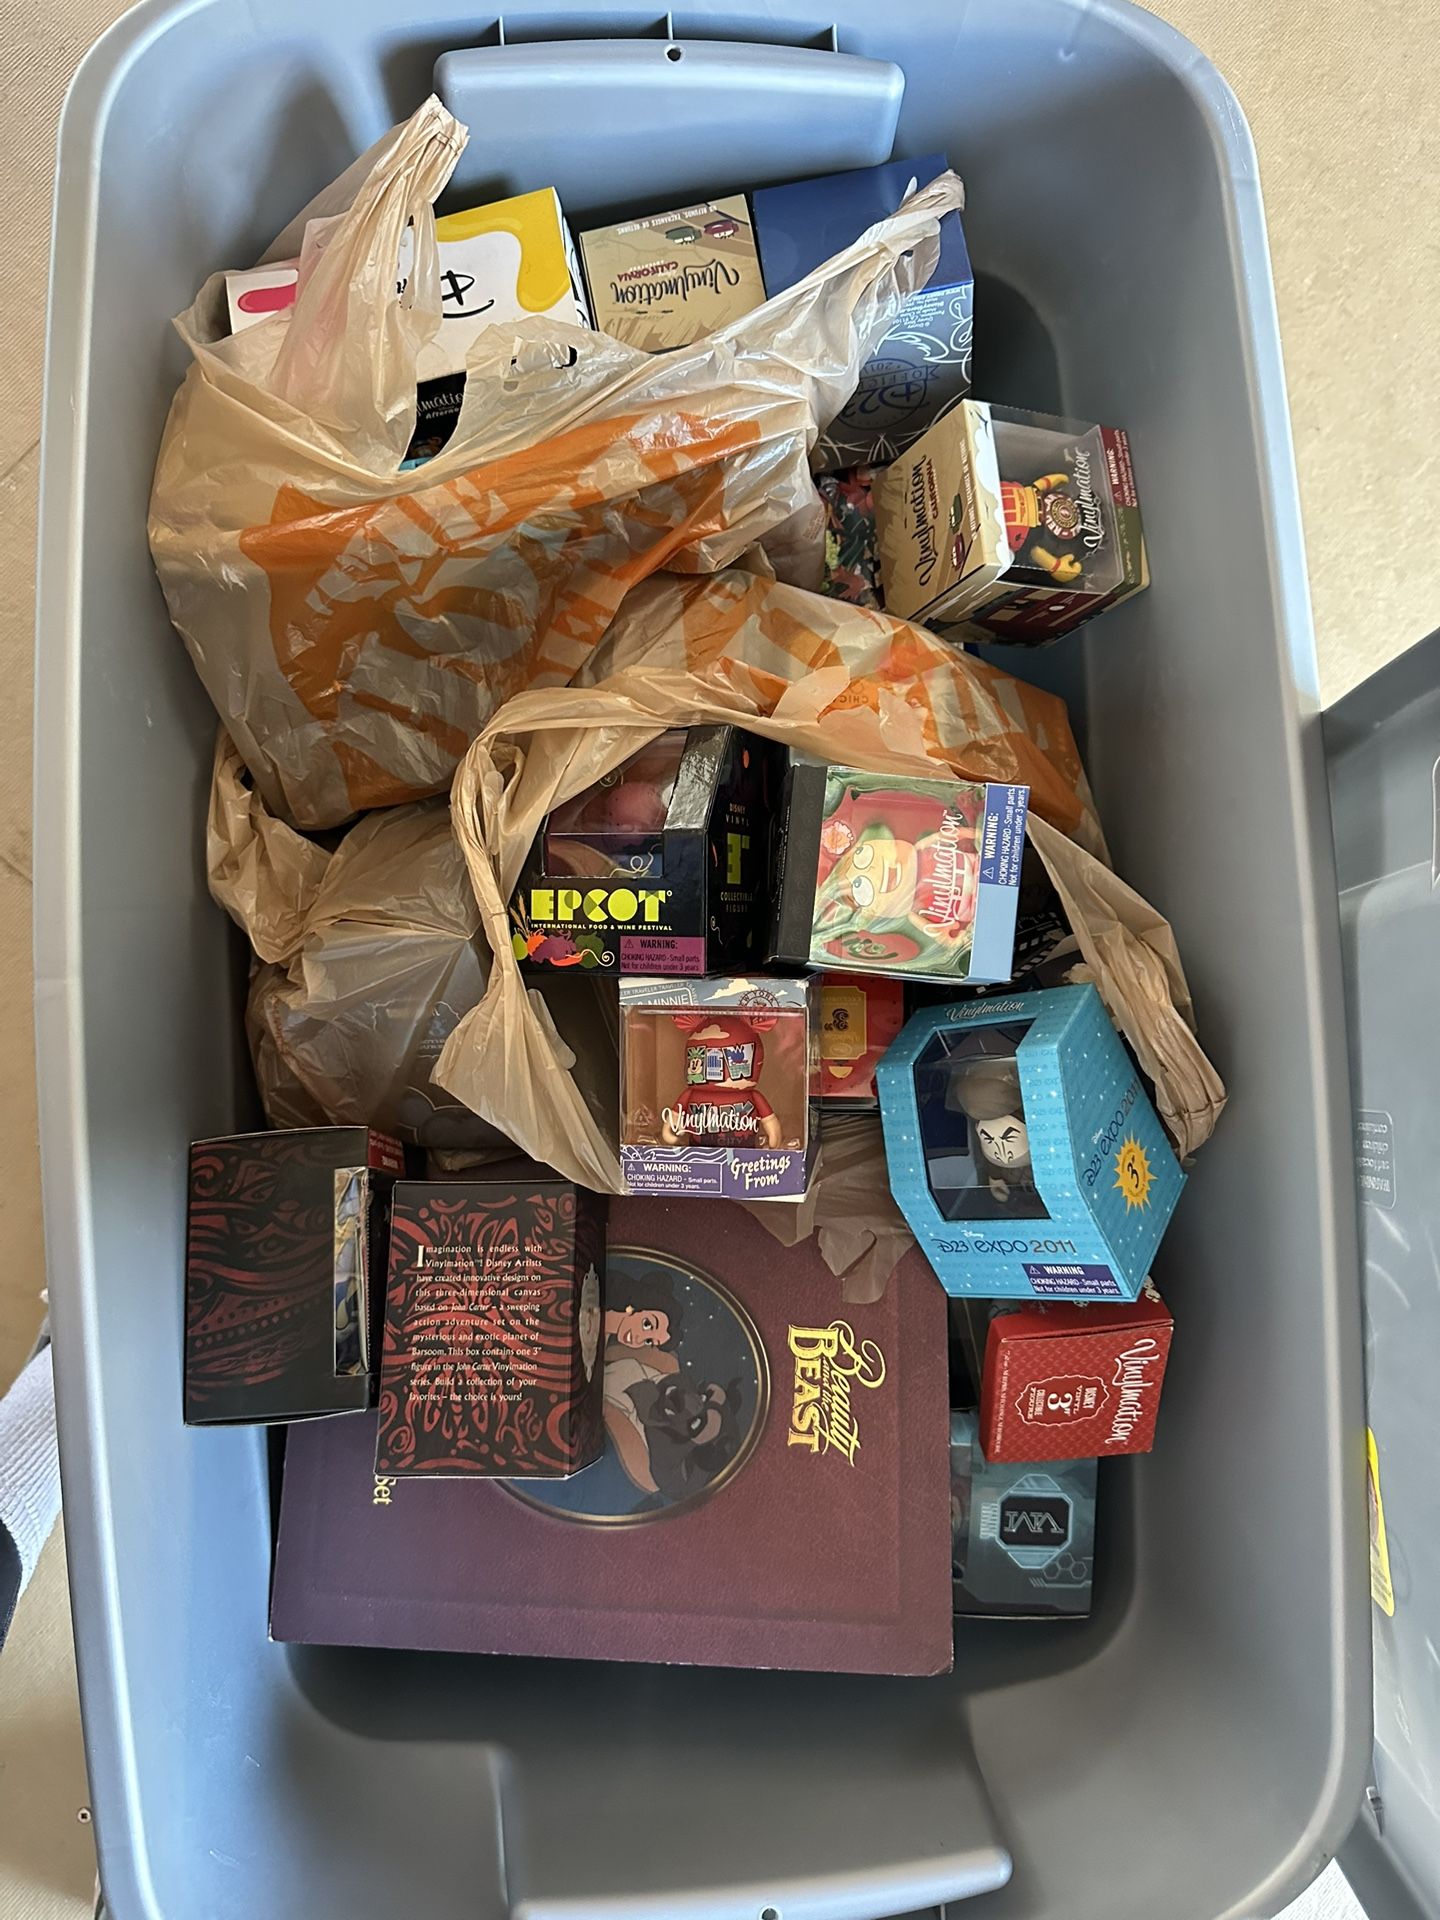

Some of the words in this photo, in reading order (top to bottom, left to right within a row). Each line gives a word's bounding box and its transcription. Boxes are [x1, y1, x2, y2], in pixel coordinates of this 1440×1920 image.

[617, 261, 679, 282] CALIFORNIA
[610, 259, 740, 305] Vinylmation
[1072, 446, 1105, 549] Vinylmation
[910, 453, 939, 587] Vinylmation
[725, 814, 750, 827] VINYL
[1004, 806, 1014, 825] Small
[1013, 815, 1023, 834] under
[984, 812, 999, 859] WARNING:
[1000, 829, 1012, 855] HAZARD
[1010, 835, 1021, 863] children
[918, 810, 963, 938] Vinylmation
[998, 856, 1009, 885] CHOKING
[1010, 863, 1018, 873] for
[1009, 874, 1018, 886] Not
[531, 888, 672, 922] EPCOT
[640, 939, 679, 949] WARNING:
[640, 962, 662, 970] children
[669, 954, 685, 963] Small
[647, 994, 690, 1006] MINNIE
[946, 1000, 1026, 1023] Vinylmation
[687, 1043, 755, 1085] NEW
[661, 1103, 762, 1136] Vinylmation
[1100, 1111, 1125, 1157] expo
[643, 1163, 692, 1174] WARNING:
[730, 1154, 791, 1181] Greetings
[627, 1173, 656, 1182] CHOKING
[657, 1174, 683, 1183] HAZARD
[688, 1176, 703, 1184] Small
[745, 1172, 780, 1190] From
[477, 1245, 484, 1253] is
[490, 1245, 519, 1253] endless
[524, 1245, 543, 1253] with
[931, 1238, 969, 1254] D23
[974, 1239, 1028, 1257] expo
[1030, 1239, 1078, 1254] 2011
[486, 1259, 512, 1268] Disney
[514, 1259, 542, 1267] Artists
[1042, 1265, 1085, 1276] WARNING
[502, 1274, 529, 1283] designs
[451, 1303, 466, 1312] John
[469, 1303, 489, 1311] Carter
[507, 1303, 541, 1312] sweeping
[414, 1318, 441, 1326] action
[445, 1318, 489, 1326] adventure
[526, 1318, 540, 1326] the
[412, 1333, 456, 1342] mysterious
[458, 1333, 473, 1341] and
[475, 1333, 500, 1341] exotic
[502, 1332, 528, 1342] planet
[530, 1332, 540, 1341] of
[412, 1347, 447, 1356] Barsoom.
[448, 1347, 464, 1356] This
[465, 1347, 480, 1356] box
[481, 1347, 515, 1356] contains
[411, 1362, 432, 1371] figure
[443, 1362, 455, 1370] the
[456, 1362, 471, 1372] John
[491, 1362, 538, 1371] Vinylmation
[821, 1356, 832, 1388] and
[434, 1377, 455, 1385] Build
[466, 1377, 503, 1385] collection
[506, 1377, 515, 1385] of
[519, 1379, 537, 1387] your
[787, 1324, 840, 1454] BEAST
[1104, 1338, 1161, 1445] Vinylmation
[409, 1392, 441, 1401] favorites
[450, 1392, 462, 1400] the
[464, 1392, 488, 1400] choice
[491, 1392, 497, 1400] is
[499, 1392, 523, 1401] yours!
[816, 1320, 886, 1468] Beauty
[821, 1389, 832, 1413] the
[1034, 1389, 1046, 1416] COLLECTIBLE
[1073, 1385, 1083, 1415] VINYL
[1083, 1387, 1098, 1409] DISNEY
[373, 1477, 398, 1506] Set
